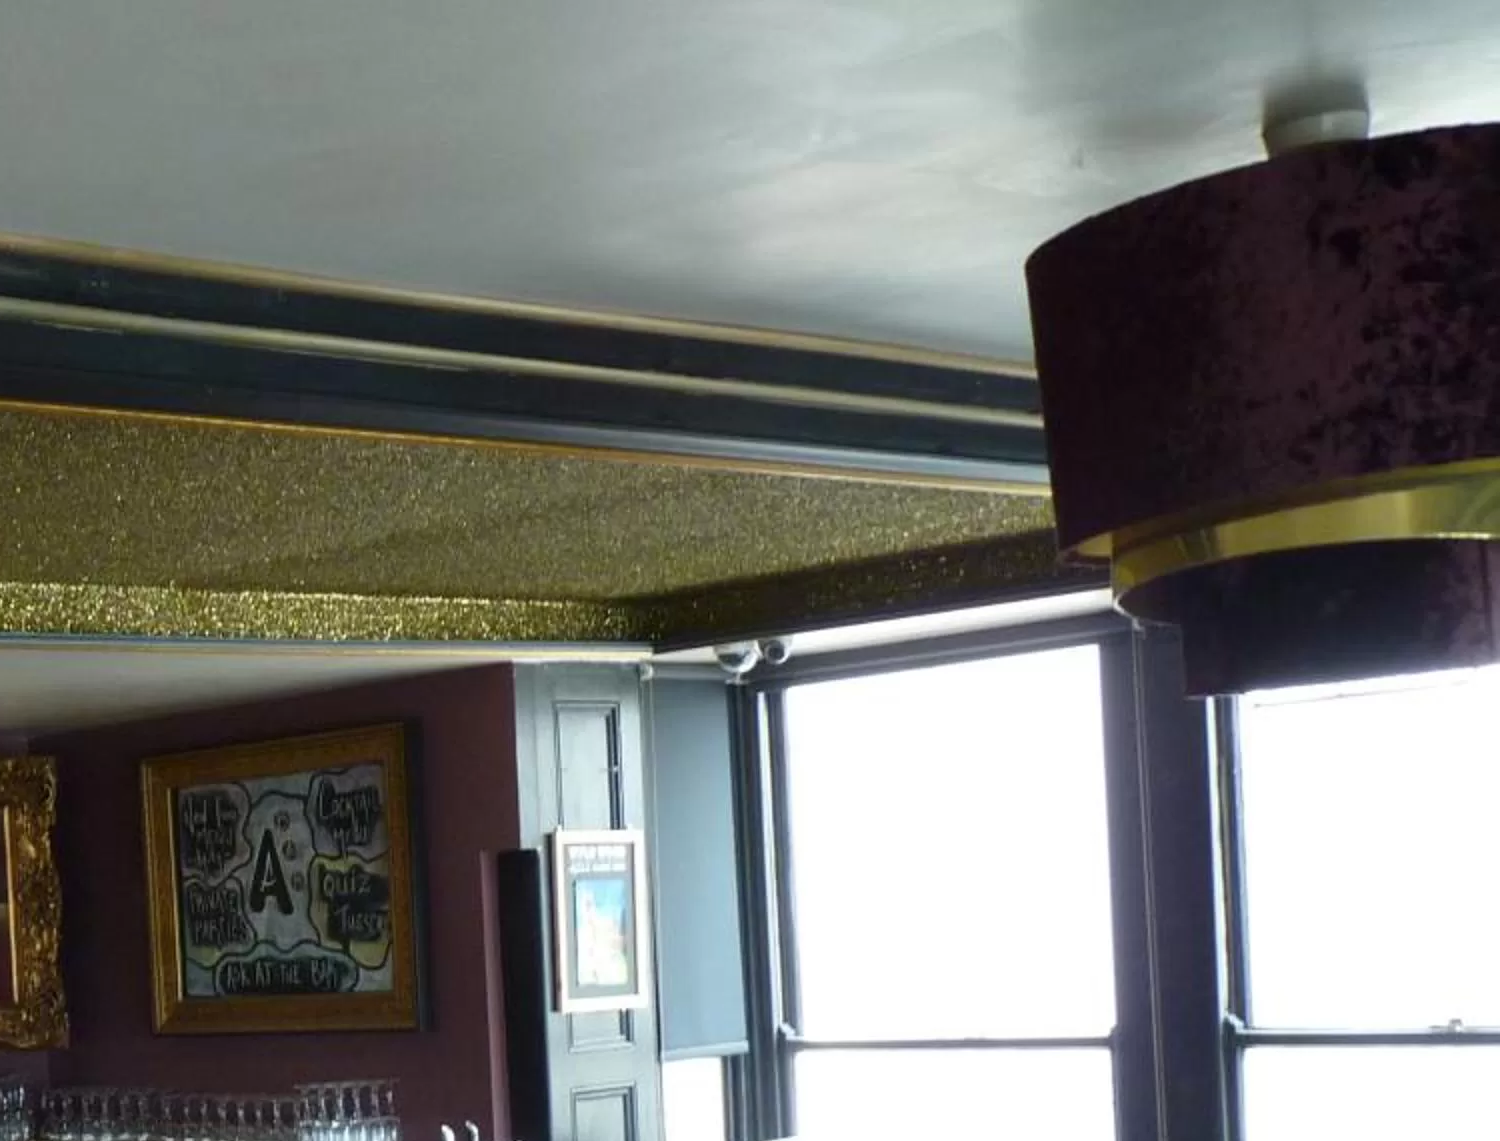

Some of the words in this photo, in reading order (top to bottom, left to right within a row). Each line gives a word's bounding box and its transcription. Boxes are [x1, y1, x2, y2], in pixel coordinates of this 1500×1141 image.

[250, 829, 294, 915] A
[323, 868, 372, 896] QUIZ
[255, 962, 272, 988] AT
